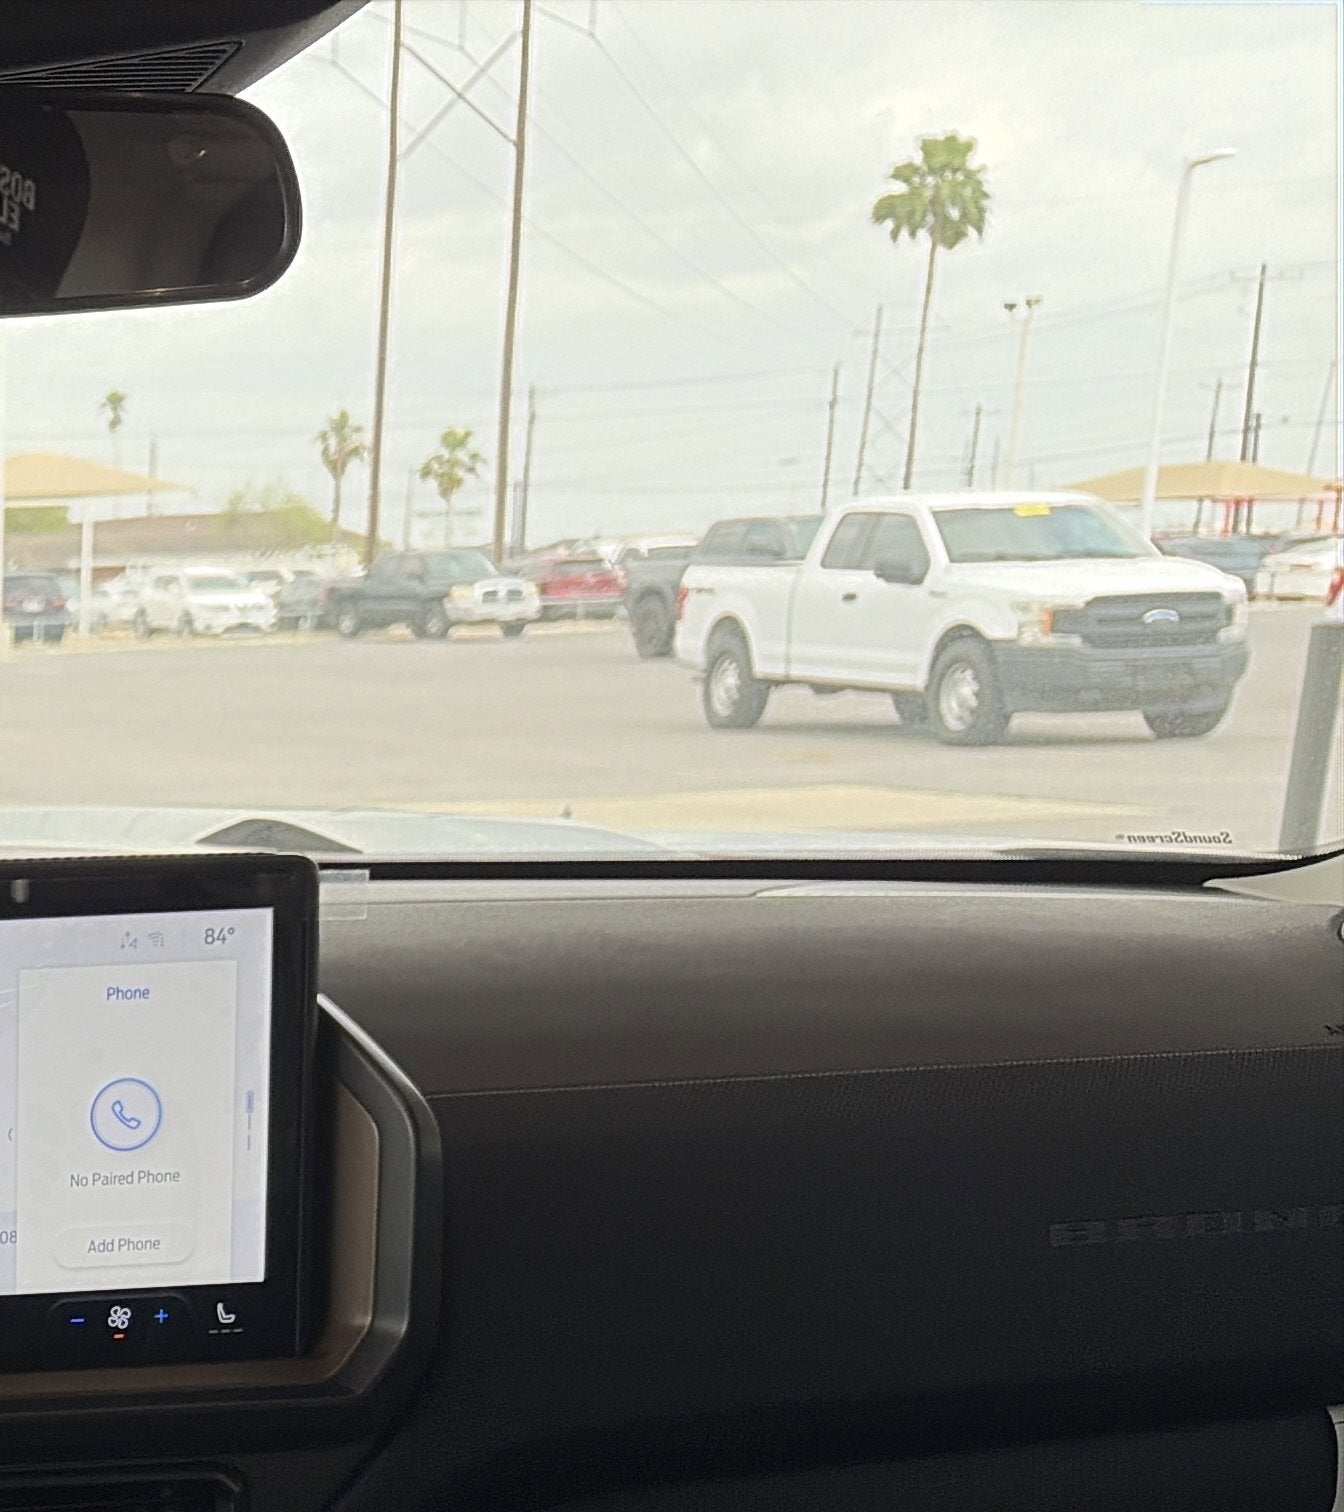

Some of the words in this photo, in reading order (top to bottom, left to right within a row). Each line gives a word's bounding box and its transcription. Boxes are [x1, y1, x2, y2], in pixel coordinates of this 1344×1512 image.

[106, 986, 150, 1001] Phone
[70, 1173, 88, 1187] No
[92, 1172, 135, 1186] Paired
[137, 1170, 180, 1184] Phone
[87, 1239, 114, 1254] Add
[117, 1238, 161, 1252] Phone
